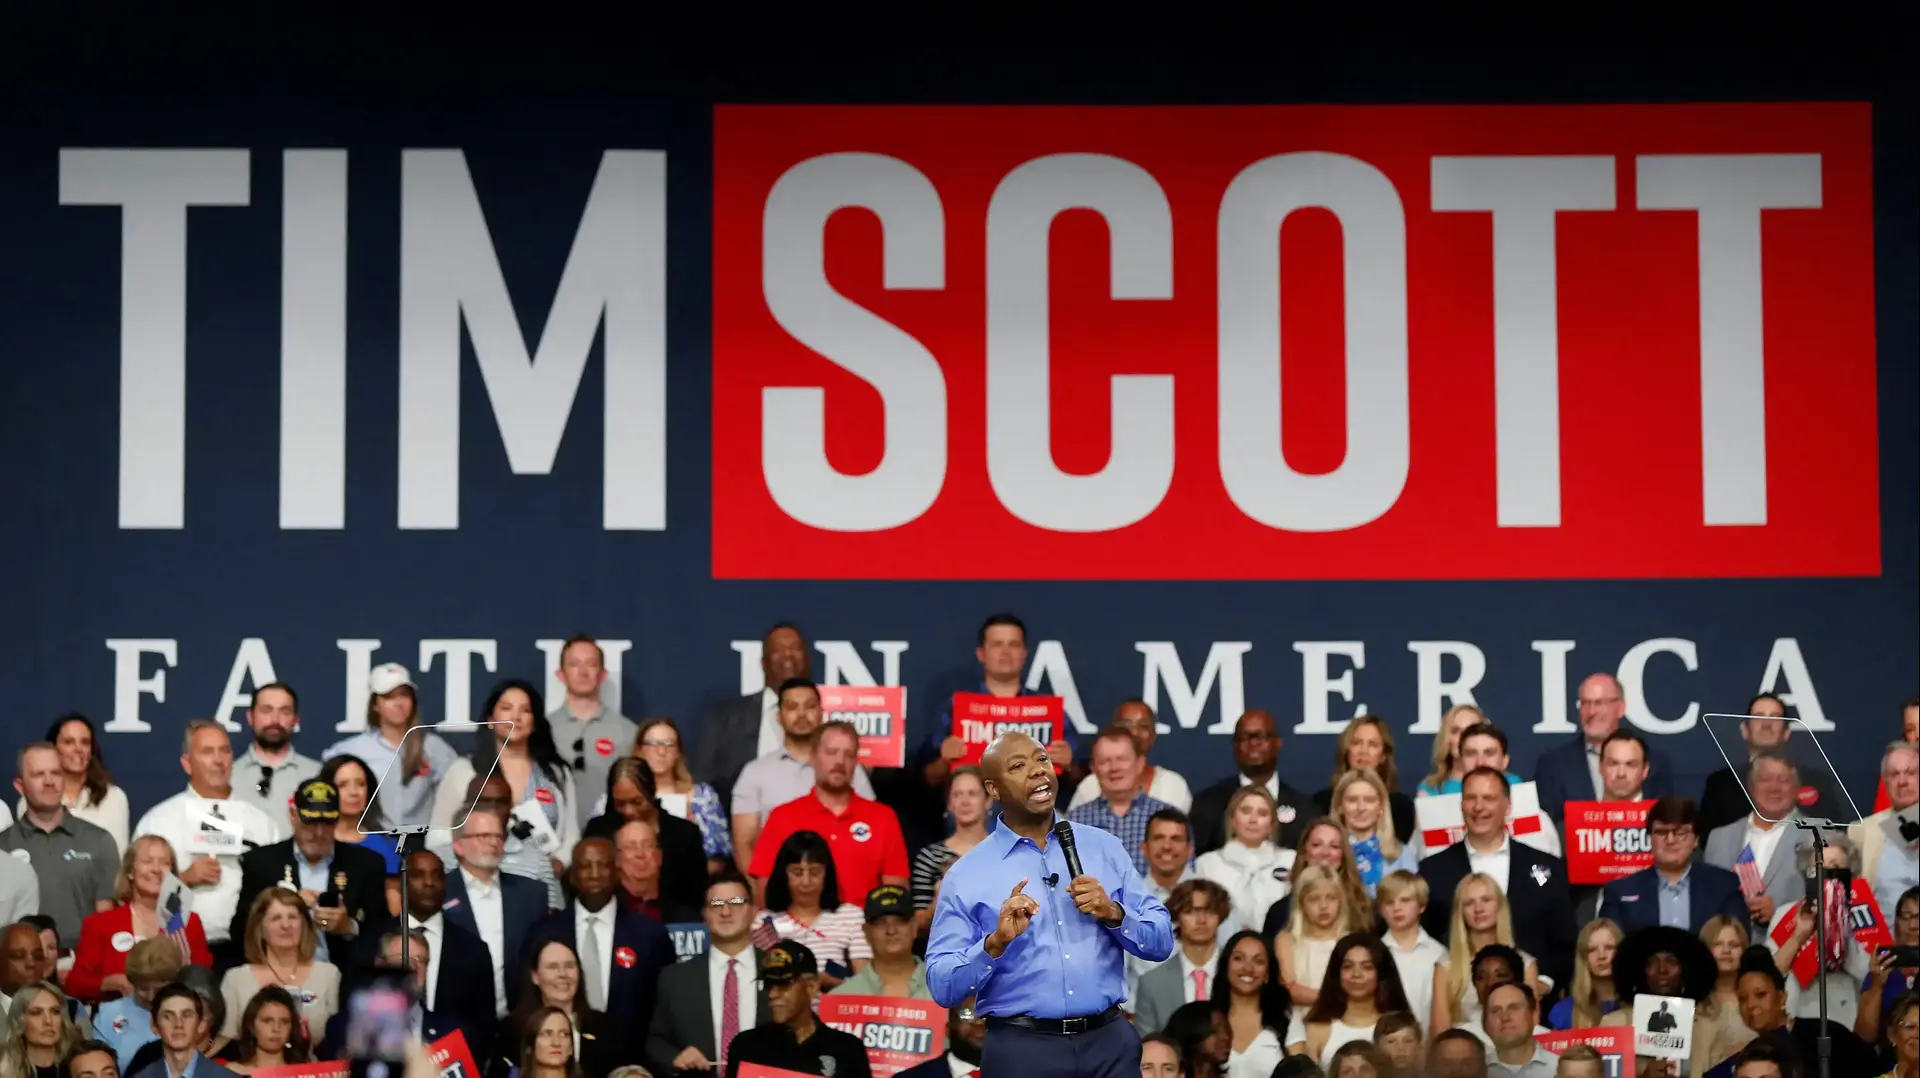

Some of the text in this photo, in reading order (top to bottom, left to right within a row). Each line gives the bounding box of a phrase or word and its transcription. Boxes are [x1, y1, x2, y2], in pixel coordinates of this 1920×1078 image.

[59, 148, 1823, 532] TIM SCOTT
[1025, 637, 1836, 736] AMERICA
[960, 719, 994, 744] TIM
[1575, 828, 1652, 853] TIM SCO
[863, 1023, 932, 1053] SCOTT
